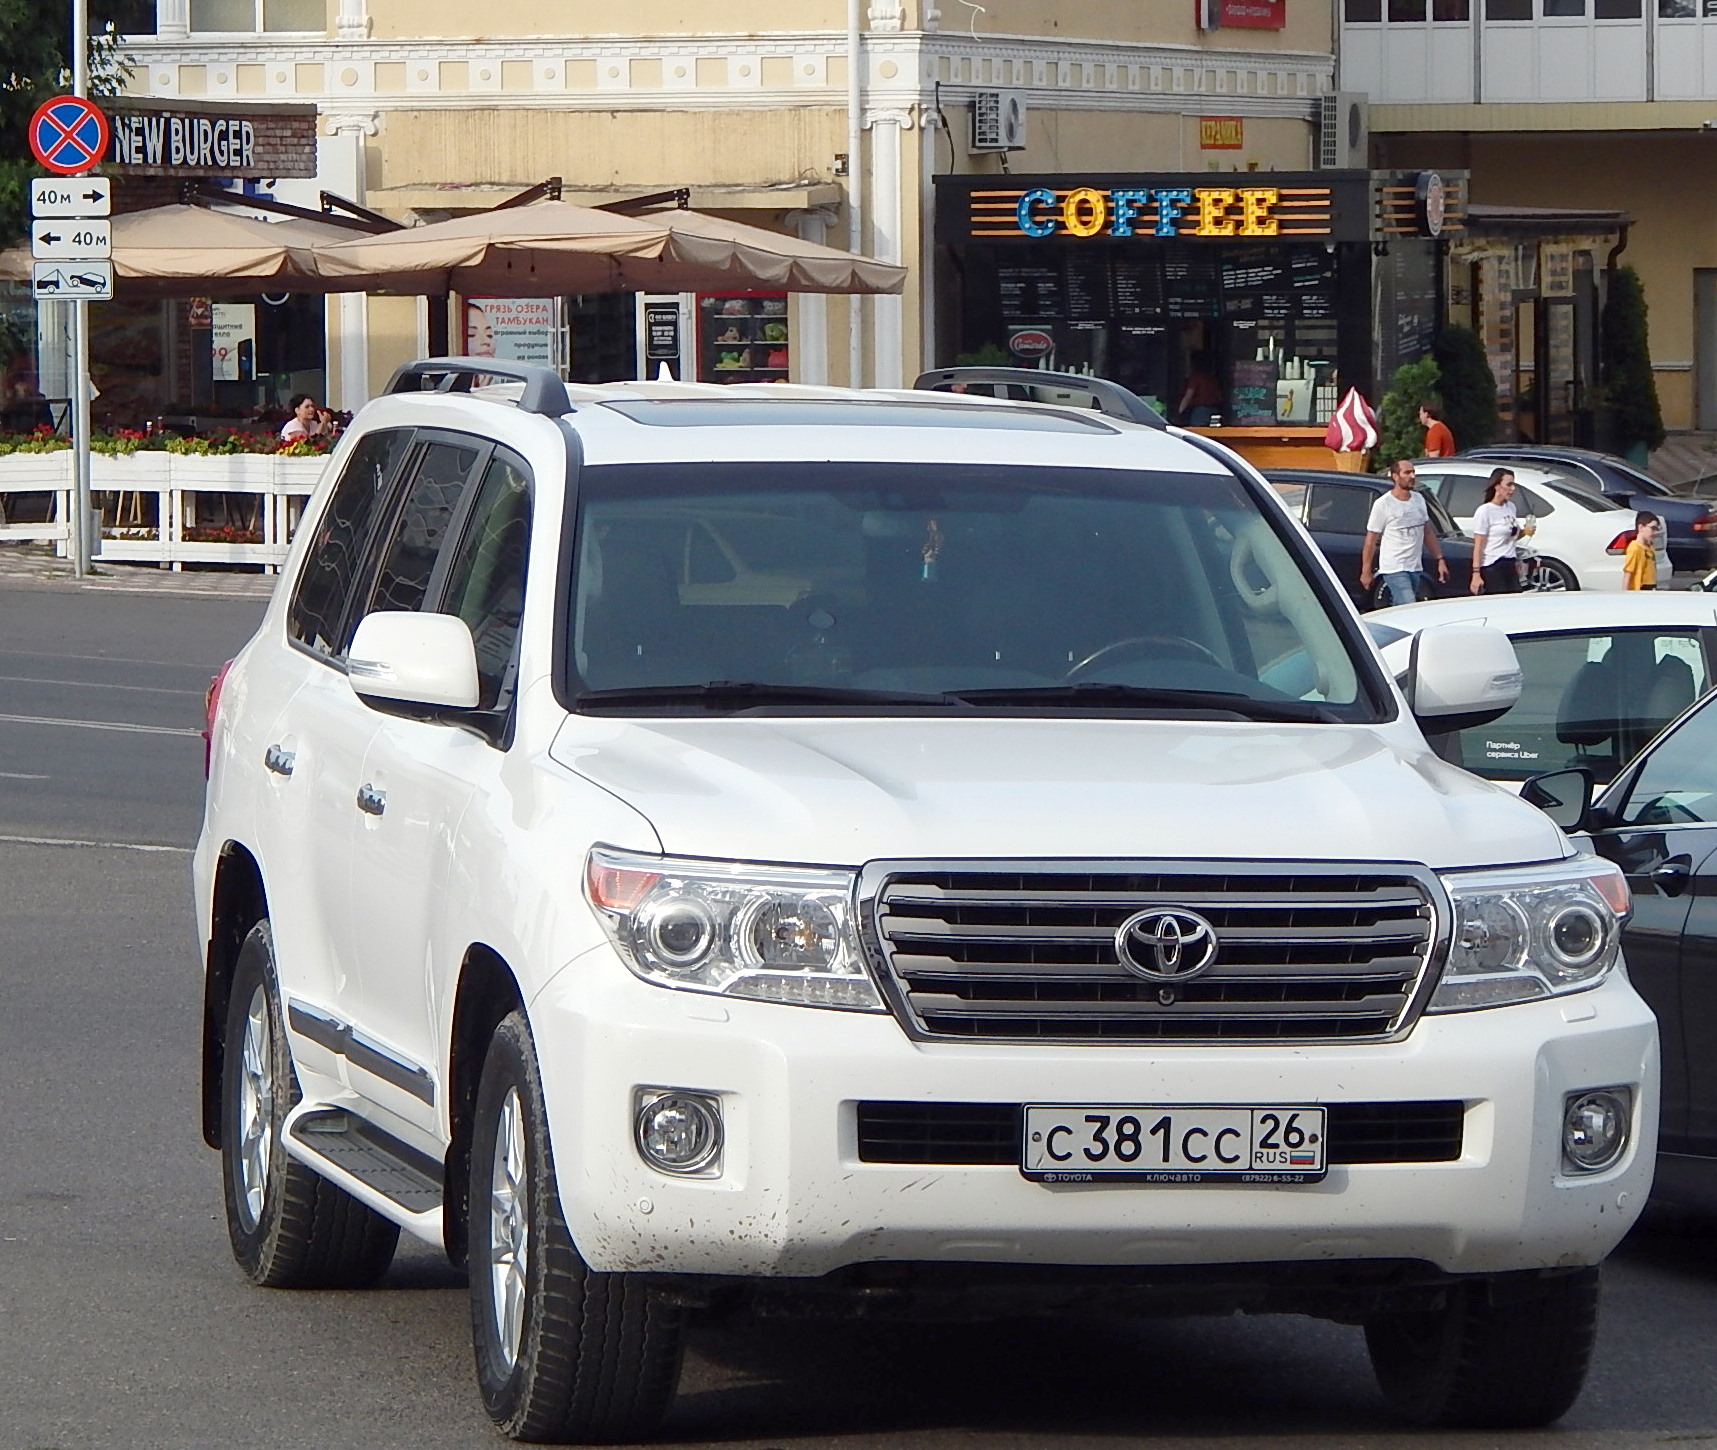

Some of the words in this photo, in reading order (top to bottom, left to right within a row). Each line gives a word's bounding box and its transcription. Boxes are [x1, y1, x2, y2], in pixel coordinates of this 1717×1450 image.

[115, 115, 165, 165] NEW
[170, 117, 255, 167] BURGER
[1017, 187, 1279, 237] COFFEE
[484, 304, 513, 313] ГРЯЗЬ
[515, 304, 549, 313] ОЗЕРА
[495, 317, 549, 325] ТАМБУКАН
[1520, 751, 1539, 759] Uber
[1258, 1113, 1305, 1150] 26
[1254, 1151, 1288, 1164] RUS
[1058, 1173, 1093, 1182] TOYOTA
